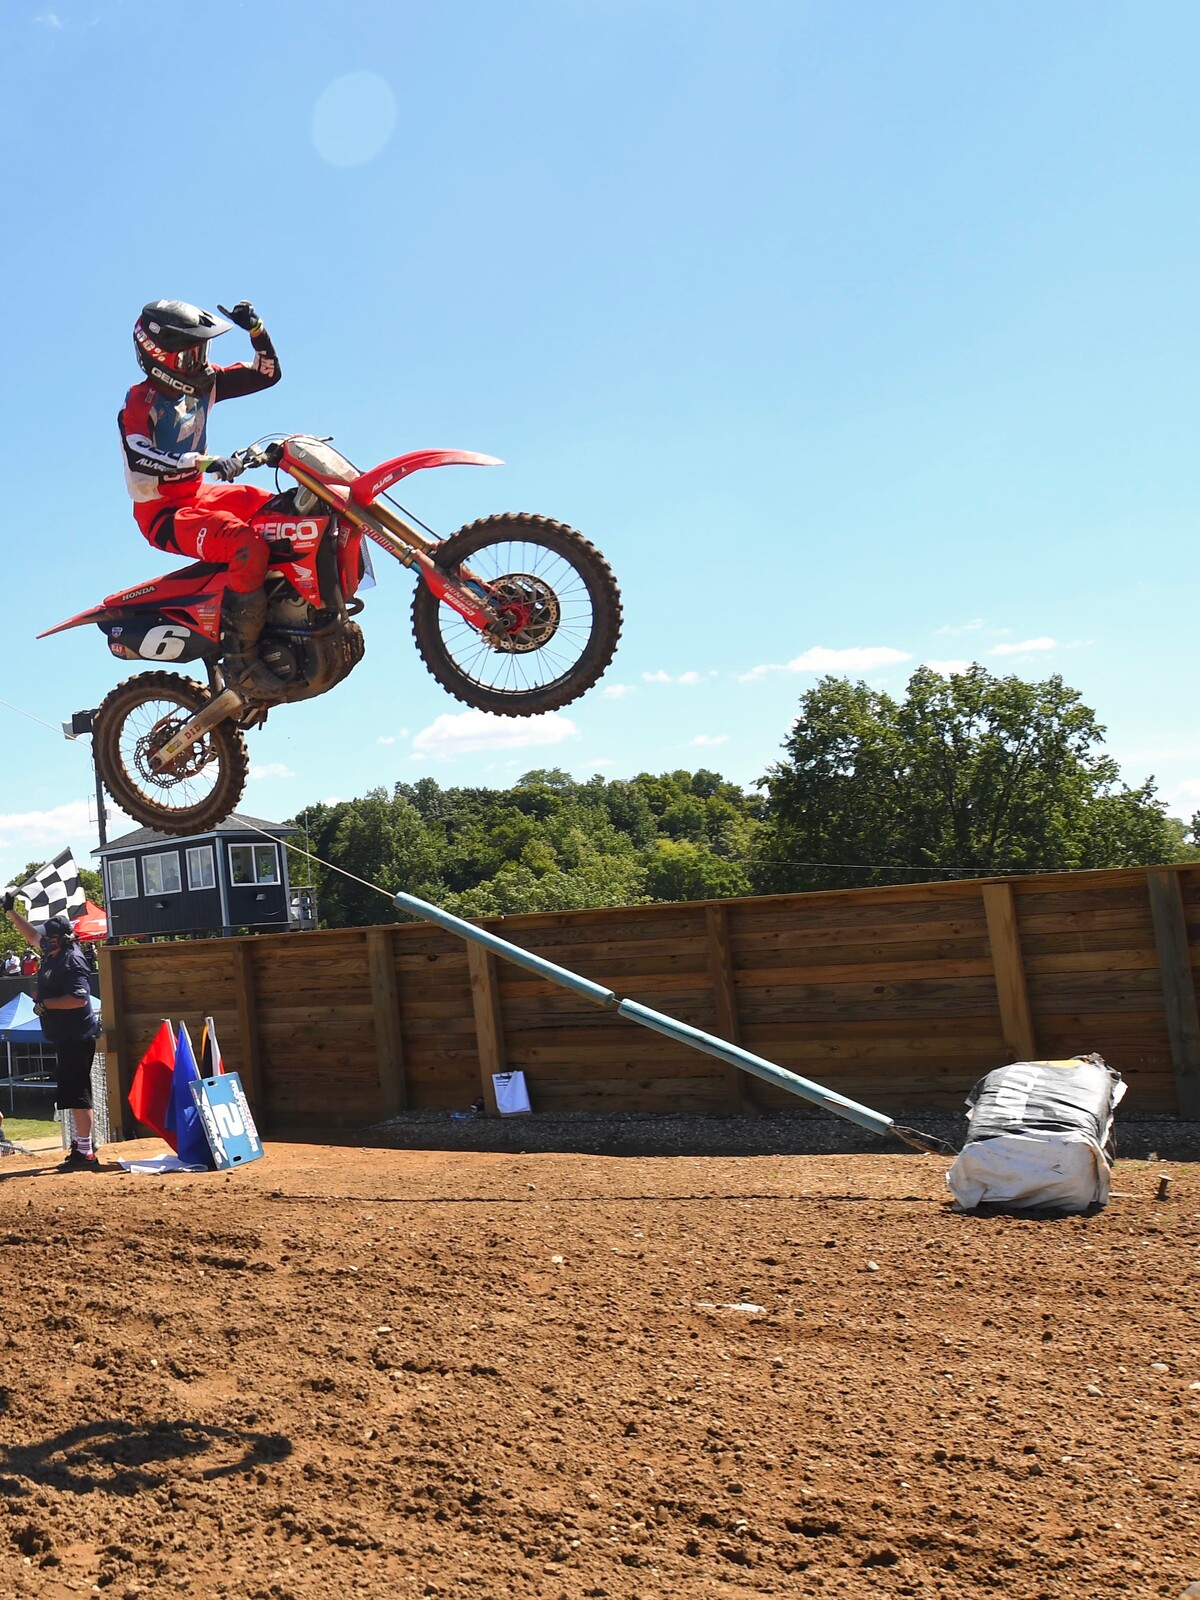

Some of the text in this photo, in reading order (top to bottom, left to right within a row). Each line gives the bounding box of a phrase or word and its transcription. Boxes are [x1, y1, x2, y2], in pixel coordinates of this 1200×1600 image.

[151, 366, 195, 395] GEICO
[359, 522, 396, 553] SHOWA
[122, 585, 156, 601] HONDA
[442, 582, 480, 610] DUNLOP
[138, 624, 191, 661] 6
[211, 1101, 245, 1139] 2
